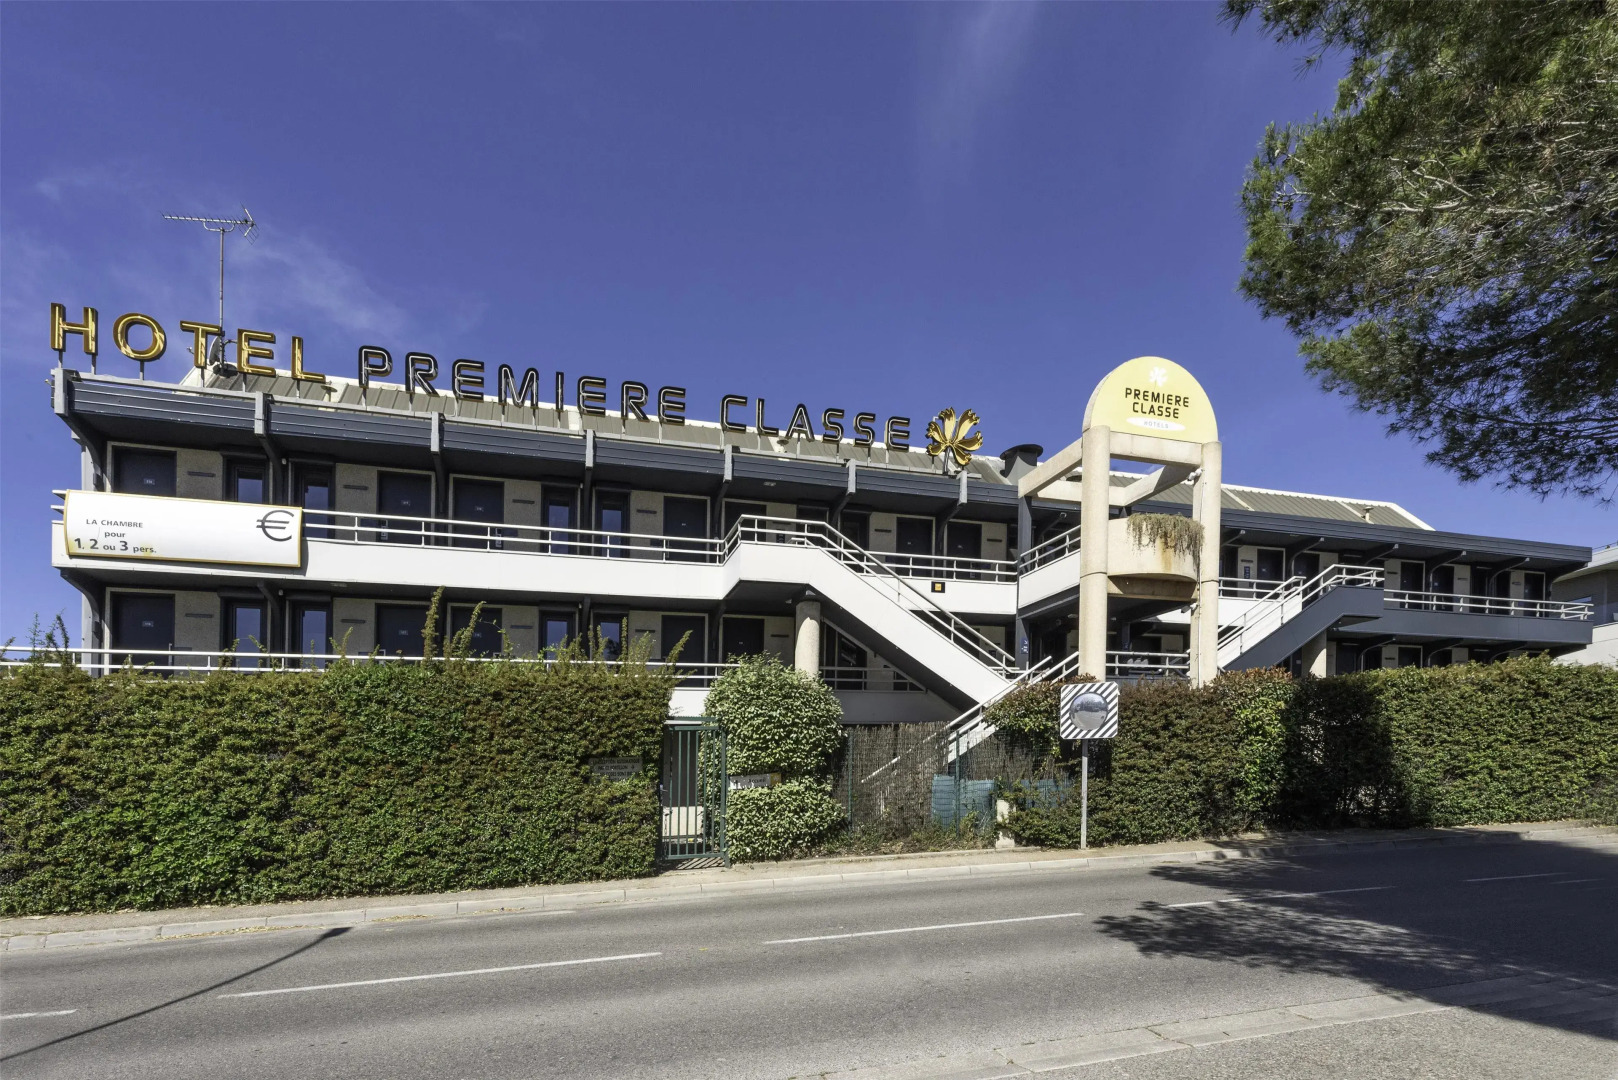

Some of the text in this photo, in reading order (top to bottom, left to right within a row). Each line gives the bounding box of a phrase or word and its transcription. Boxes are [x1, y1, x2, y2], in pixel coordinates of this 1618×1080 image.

[51, 302, 911, 452] HOTEL PREMIERE CLASSE
[1125, 387, 1189, 408] PREMIERE
[1132, 402, 1179, 419] CLASSE
[101, 519, 143, 528] CHAMBRE
[89, 538, 99, 550] 2
[119, 540, 129, 551] 3
[132, 546, 157, 554] pers.
